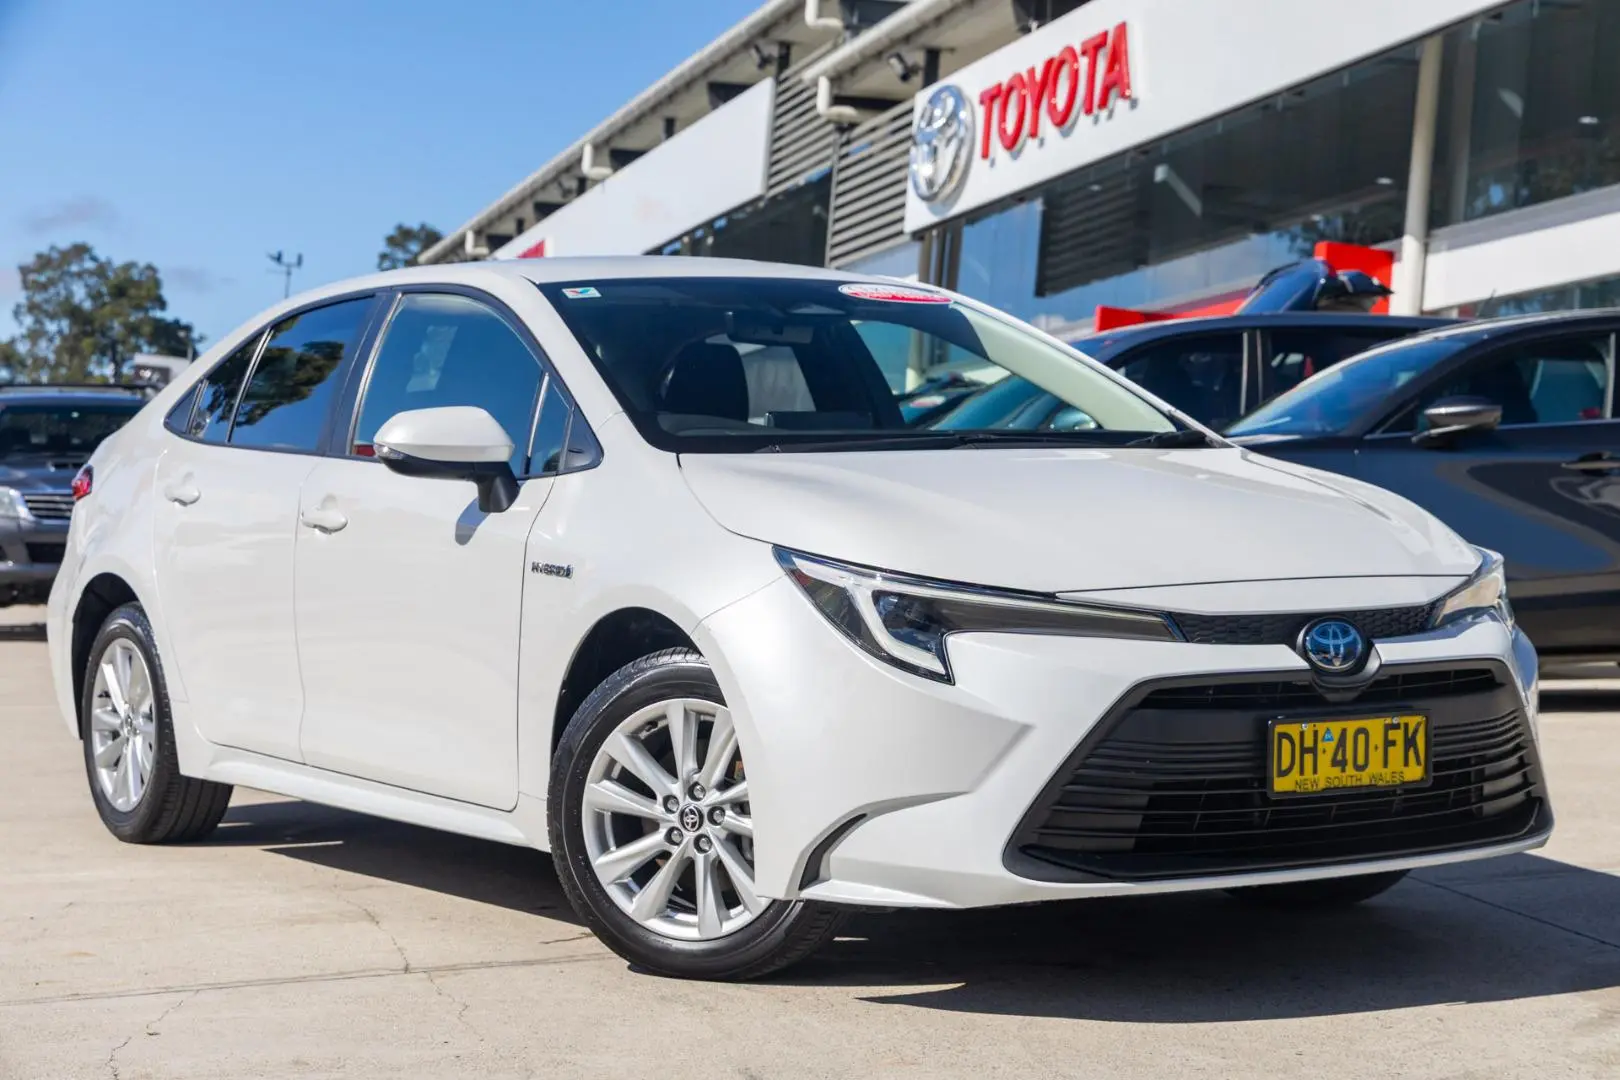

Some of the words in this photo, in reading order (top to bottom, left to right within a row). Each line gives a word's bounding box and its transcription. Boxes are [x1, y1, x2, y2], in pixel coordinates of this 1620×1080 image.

[979, 21, 1131, 160] TOYOTA
[1294, 778, 1320, 792] NEW
[1324, 773, 1363, 788] SOUTH
[1368, 770, 1405, 785] WALES
